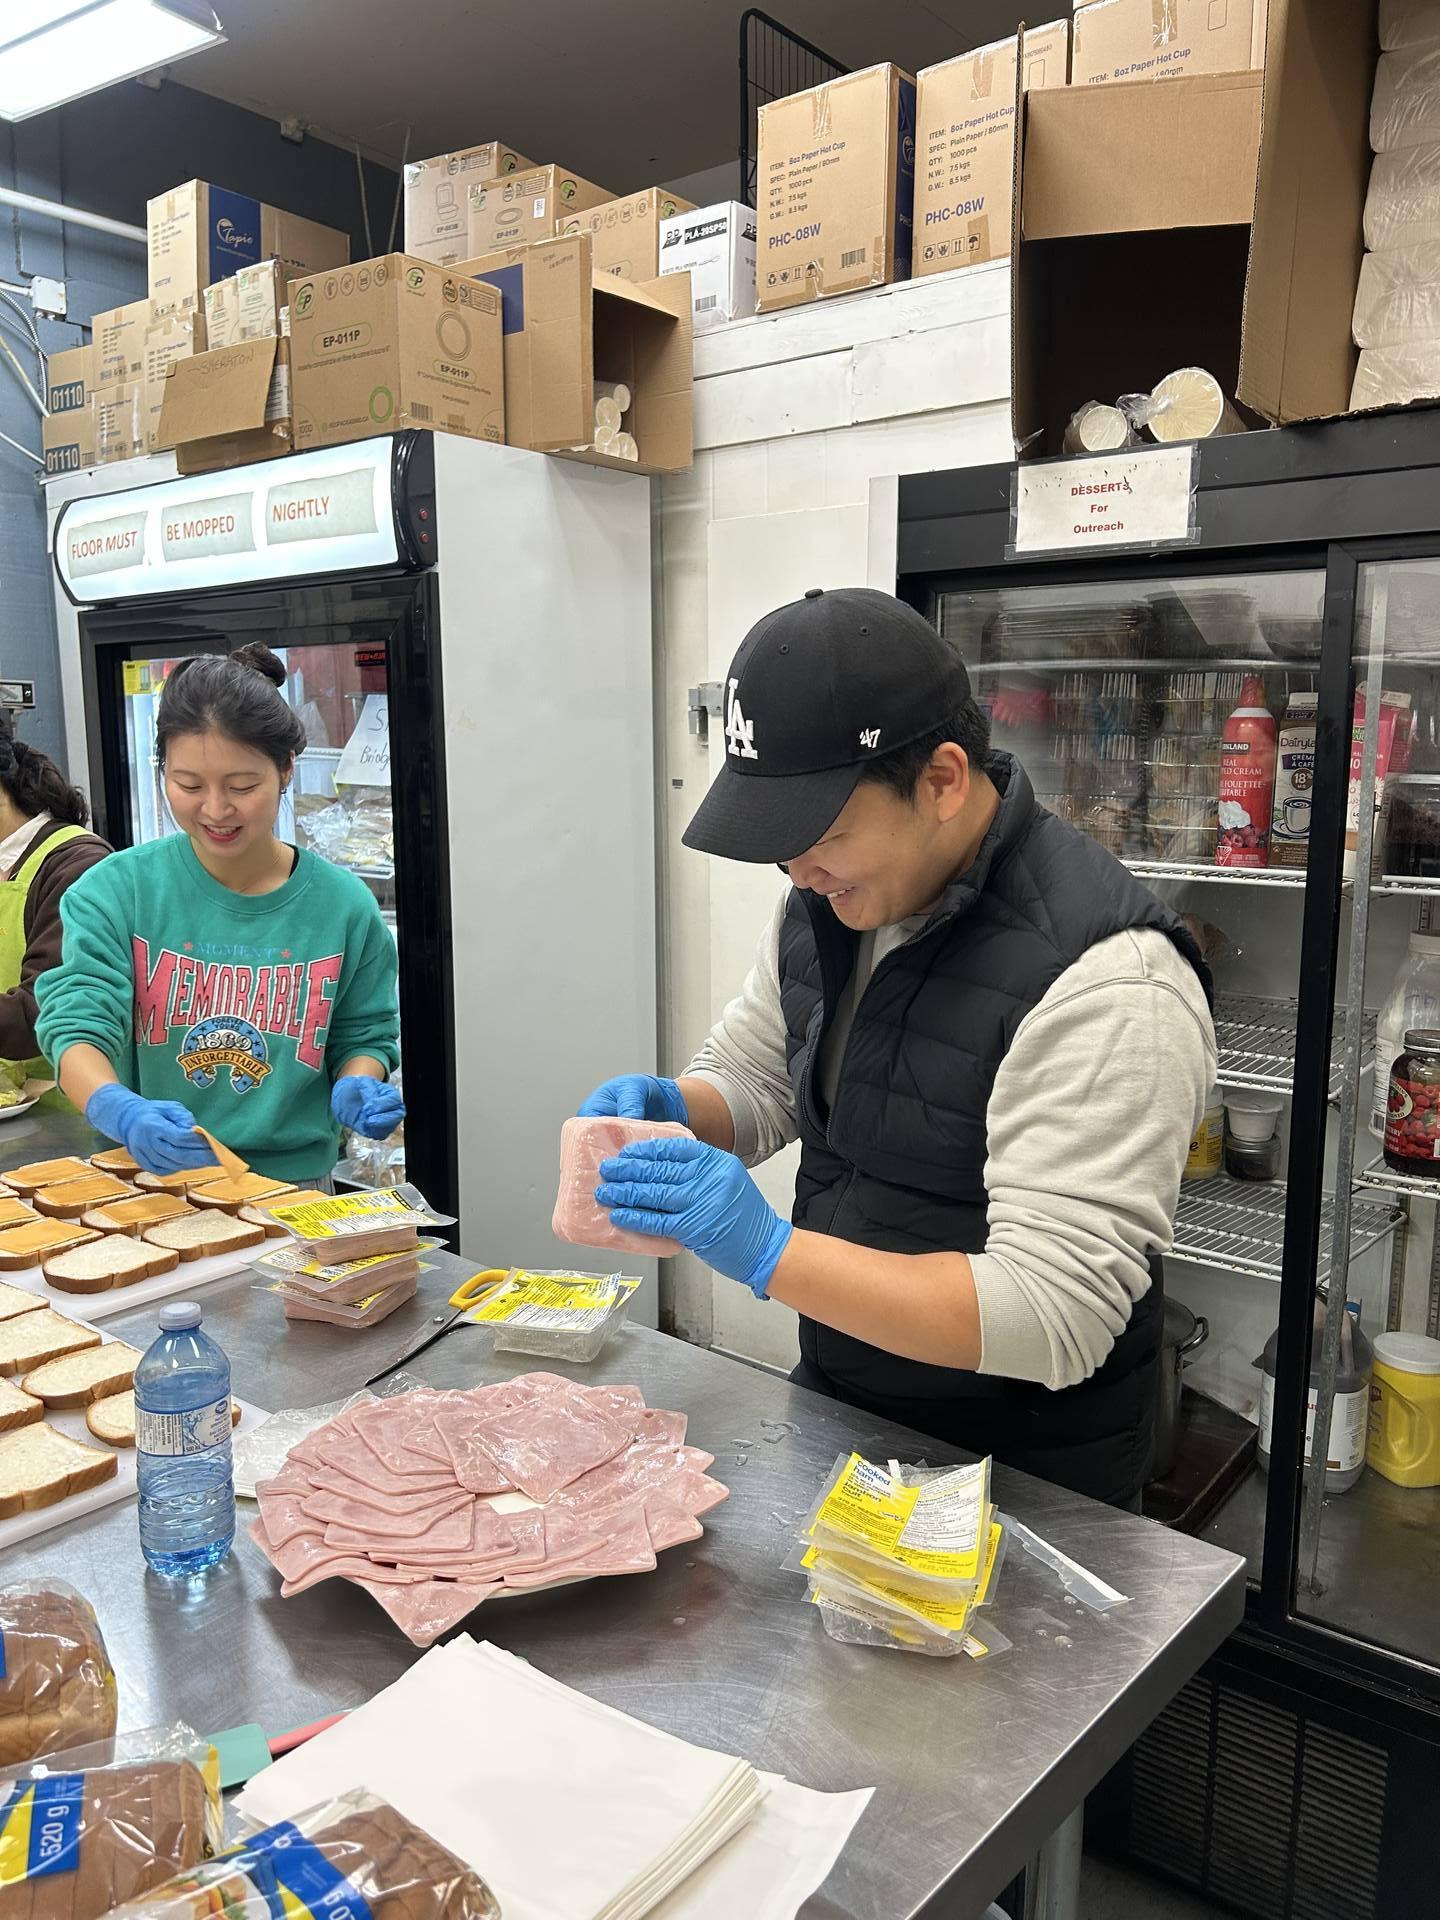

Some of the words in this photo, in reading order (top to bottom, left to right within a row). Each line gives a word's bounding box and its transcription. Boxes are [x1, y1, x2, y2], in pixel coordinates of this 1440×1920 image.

[1114, 66, 1129, 78] 8oz
[1130, 60, 1155, 74] Paper
[1156, 54, 1172, 64] Hot
[1173, 48, 1191, 60] Cup
[929, 130, 946, 140] ITEM:
[950, 122, 963, 134] 8oz
[964, 116, 986, 128] Paper
[986, 110, 998, 121] Hot
[1000, 106, 1014, 118] Cup
[929, 143, 946, 154] SPEC:
[950, 136, 966, 146] Plain
[966, 130, 984, 142] Paper
[988, 122, 1008, 134] 80mm
[770, 162, 785, 172] ITEM:
[789, 153, 800, 165] 8oz
[801, 149, 820, 162] Paper
[820, 146, 832, 154] Hot
[832, 141, 846, 152] Cup
[928, 156, 943, 167] QTY:
[950, 150, 966, 160] 1000
[966, 146, 977, 156] pcs
[960, 160, 970, 172] kgs
[770, 174, 786, 184] SPEC:
[788, 168, 802, 178] Plain
[802, 163, 818, 174] Paper
[960, 173, 971, 184] kgs
[770, 187, 783, 196] QTY:
[789, 181, 802, 190] 1000
[802, 178, 812, 187] pcs
[798, 192, 808, 201] kgs
[798, 203, 808, 213] kgs
[925, 197, 984, 226] PHC-08W
[769, 222, 821, 249] PHC-08W
[322, 330, 360, 348] EP-011P
[440, 364, 470, 379] EP-011P
[52, 384, 83, 411] 01110
[47, 446, 78, 472] 01110
[1071, 482, 1130, 496] DESSERTS
[272, 496, 330, 522] NIGHTLY
[1090, 504, 1108, 513] For
[166, 524, 180, 541] BE
[182, 516, 235, 538] MOPPED
[1074, 521, 1124, 534] Outreach
[72, 542, 103, 560] FLOOR
[105, 531, 138, 552] MUST
[368, 708, 388, 732] S
[726, 678, 758, 760] LA
[1280, 738, 1316, 750] Dairyla
[360, 742, 390, 772] Bridg
[198, 943, 277, 960] MOMENT
[133, 933, 344, 1072] MEMORABLE
[197, 1032, 252, 1051] 1869
[184, 1051, 264, 1077] UNFORGETTABLE
[853, 1465, 874, 1484] ham
[857, 1460, 891, 1486] cooked
[47, 1804, 70, 1818] g
[40, 1822, 64, 1858] 520
